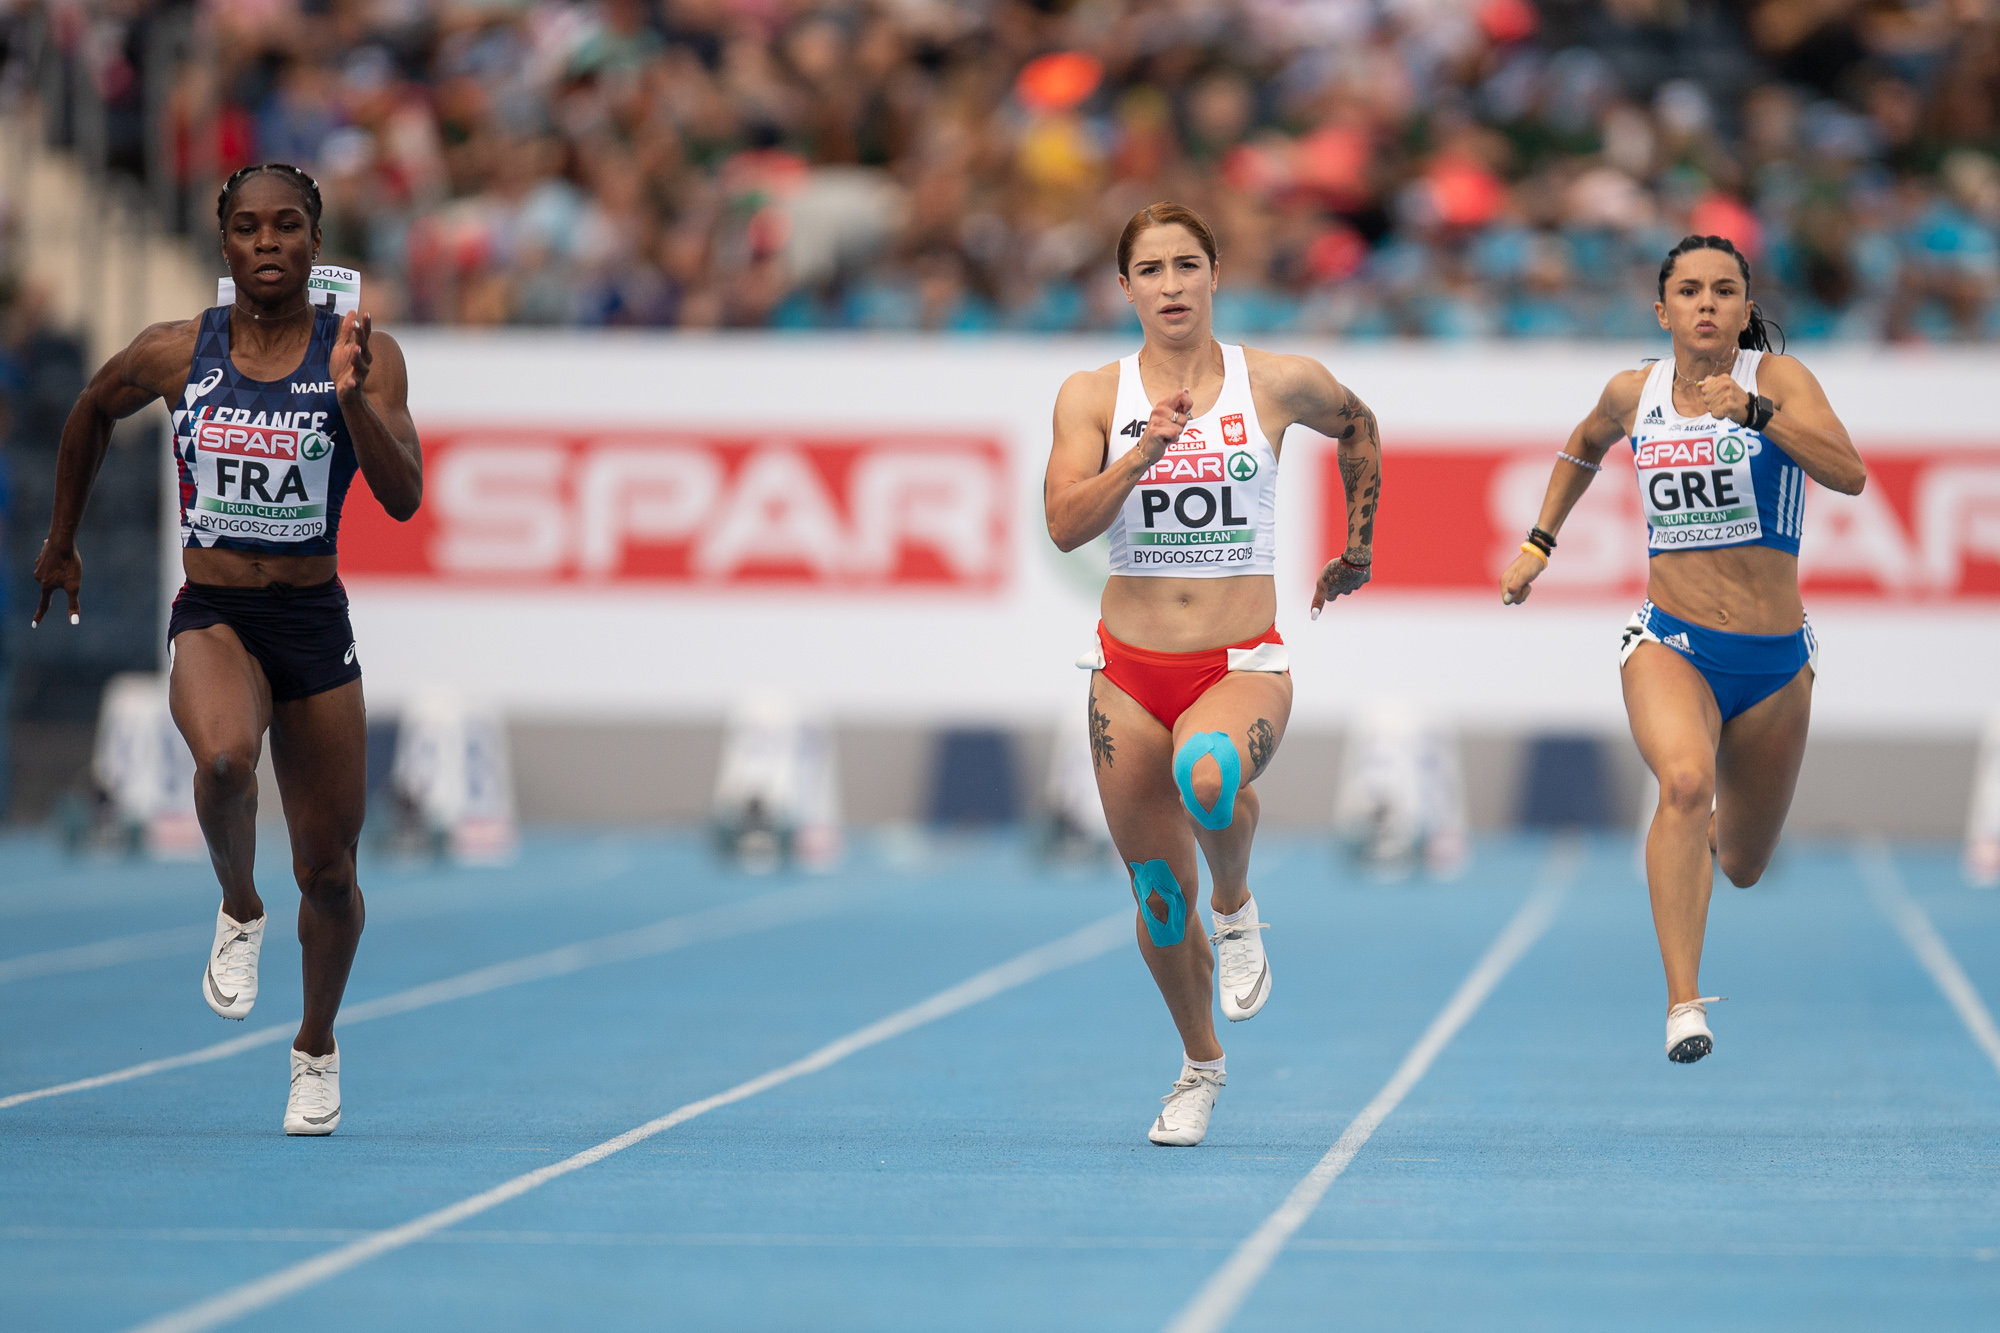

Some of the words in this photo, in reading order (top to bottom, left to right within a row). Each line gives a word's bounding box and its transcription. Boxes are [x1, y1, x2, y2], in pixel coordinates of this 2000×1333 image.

[290, 381, 335, 394] MAIF
[1221, 414, 1242, 422] POLSKA
[1683, 423, 1717, 432] AEGEAN
[201, 427, 295, 457] SPAR
[1169, 442, 1205, 451] ORLEN
[1638, 440, 1713, 465] SPAR
[216, 457, 310, 503] FRA
[1648, 468, 1741, 511] GRE
[220, 502, 225, 512] I
[227, 503, 254, 515] RUN
[428, 438, 1002, 580] SPAR
[1141, 486, 1247, 528] POL
[200, 514, 290, 537] BYDGOSZCZ
[293, 521, 323, 537] 2019
[1663, 514, 1688, 525] RUN
[1154, 534, 1158, 544] I
[1160, 533, 1187, 544] RUN
[1654, 527, 1723, 545] BYDGOSZCZ
[1725, 521, 1757, 538] 2019
[1134, 549, 1224, 563] BYDGOSZCZ
